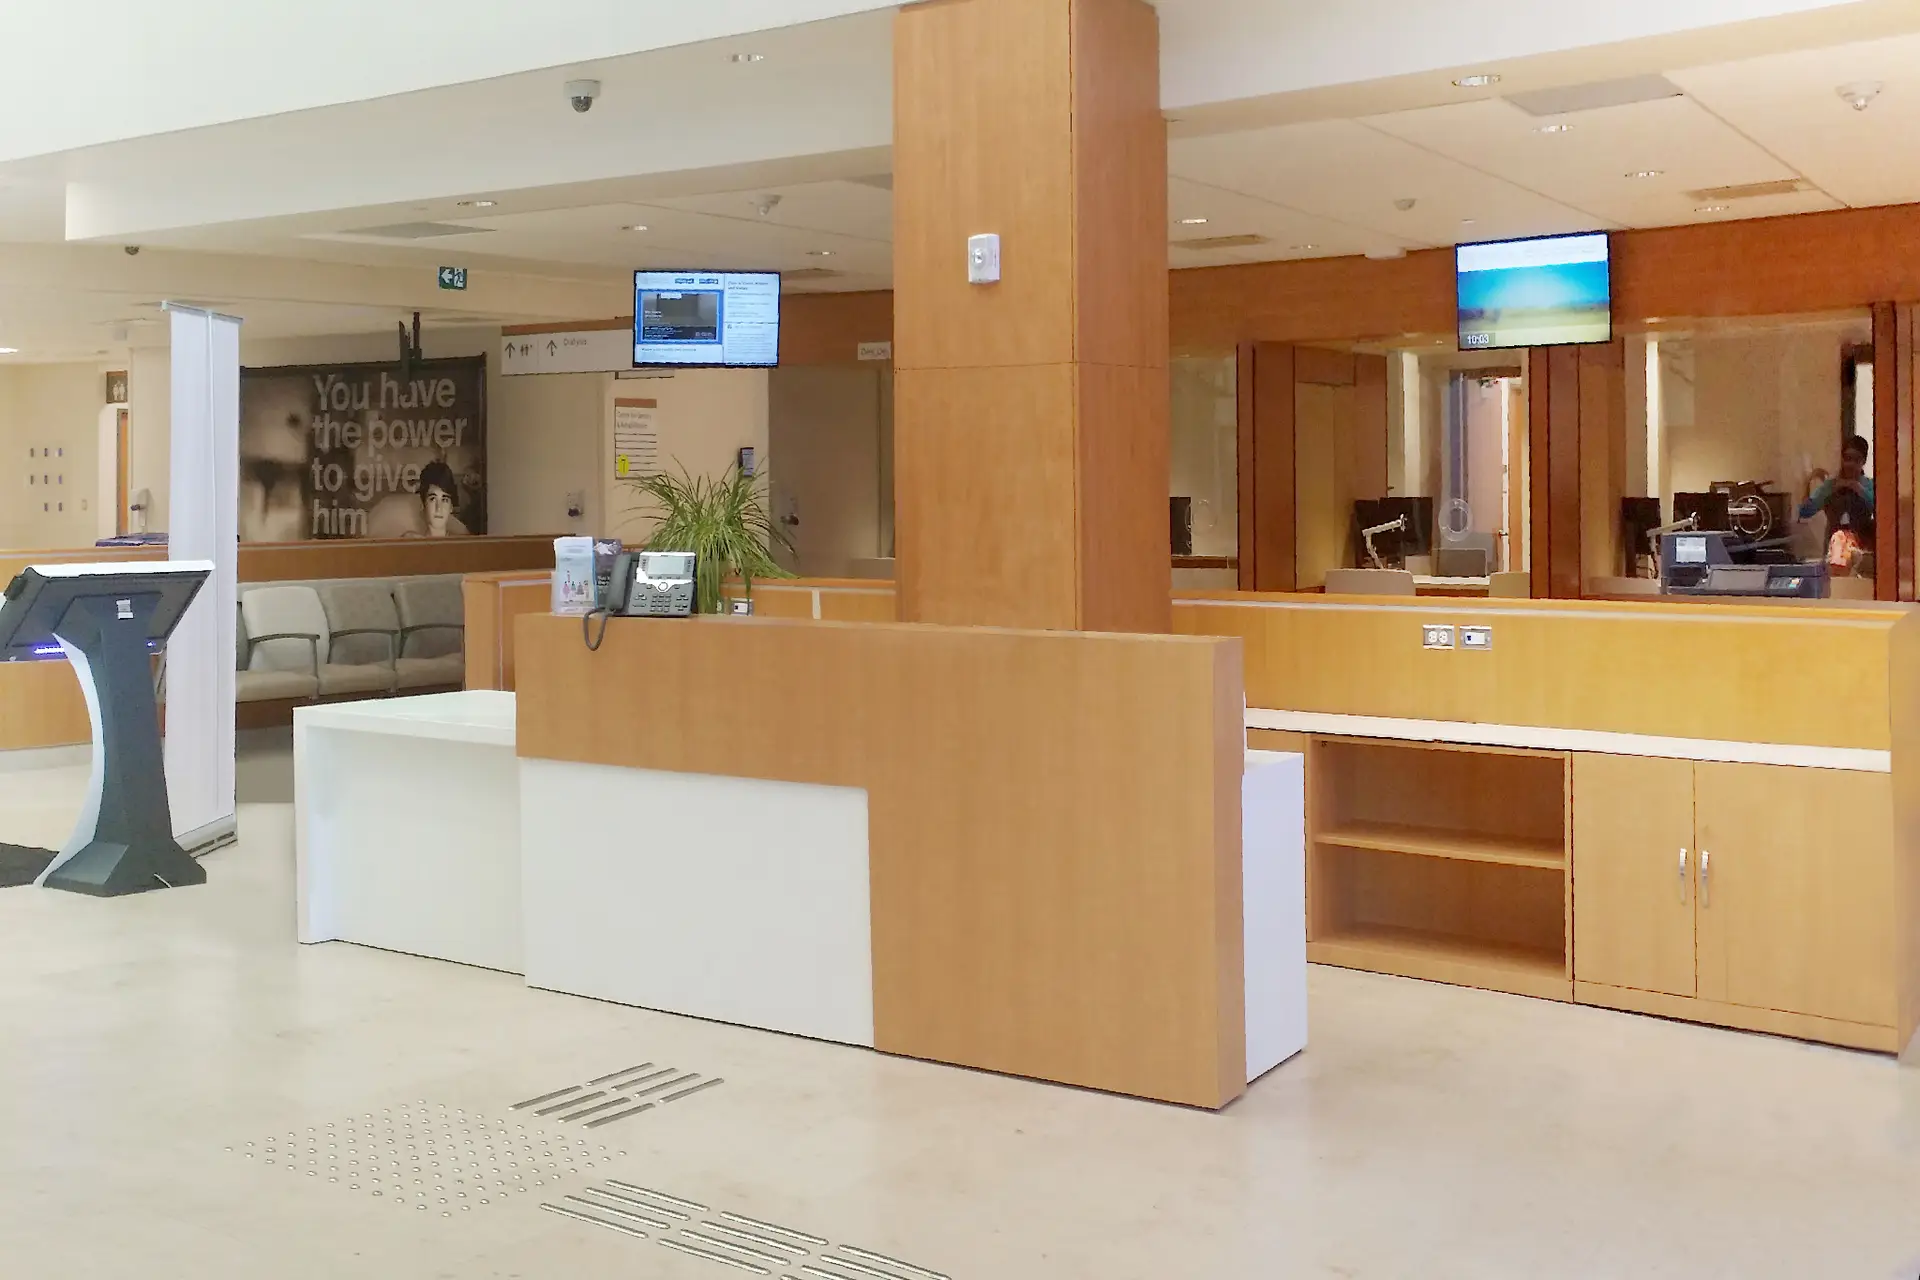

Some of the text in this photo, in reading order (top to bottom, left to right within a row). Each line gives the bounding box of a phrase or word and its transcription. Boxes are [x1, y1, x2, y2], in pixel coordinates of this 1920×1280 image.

[1467, 333, 1489, 345] 10:03
[313, 372, 456, 411] You have
[312, 413, 468, 458] the power
[312, 454, 421, 502] to give
[312, 498, 368, 535] him
